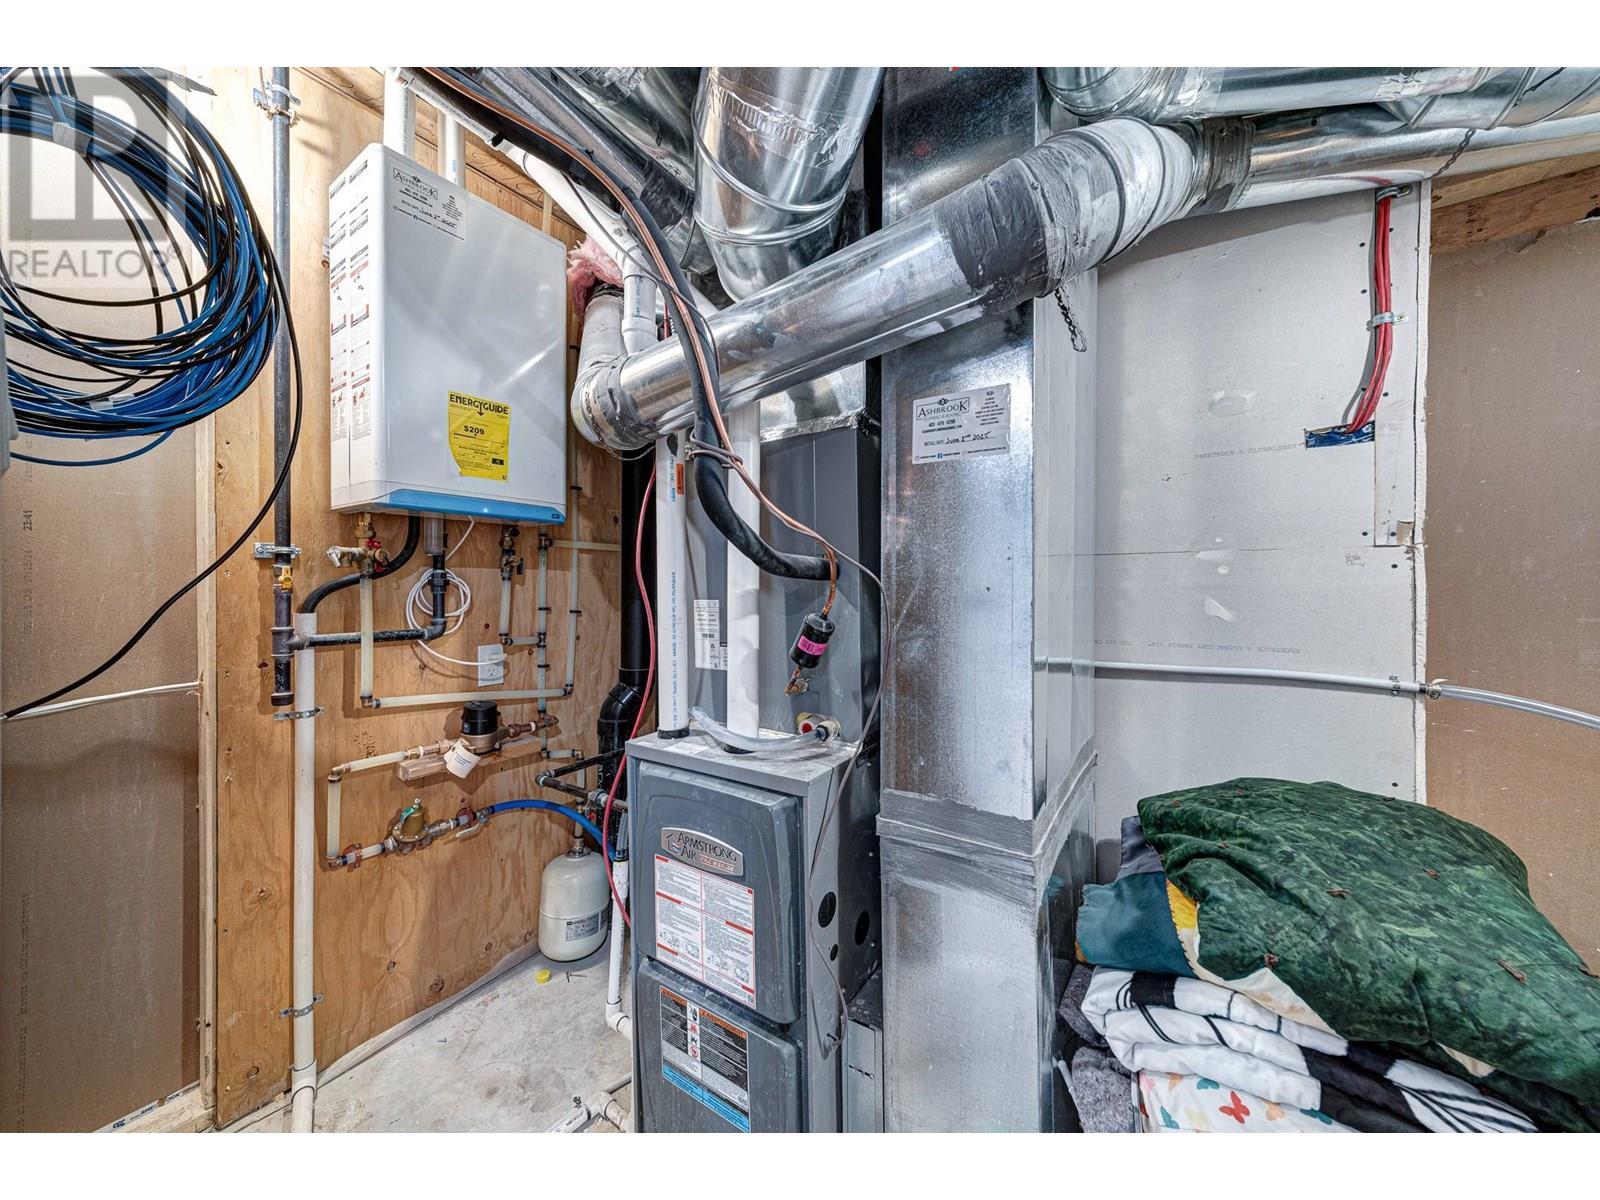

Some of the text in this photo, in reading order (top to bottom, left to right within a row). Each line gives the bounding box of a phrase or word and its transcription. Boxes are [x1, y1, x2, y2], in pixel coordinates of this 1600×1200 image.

[449, 393, 510, 416] ENERGYGUIDE
[918, 399, 968, 418] ASHBROOK
[463, 425, 485, 436] $209
[677, 831, 737, 862] ARMSTRONG
[680, 846, 697, 860] AIR
